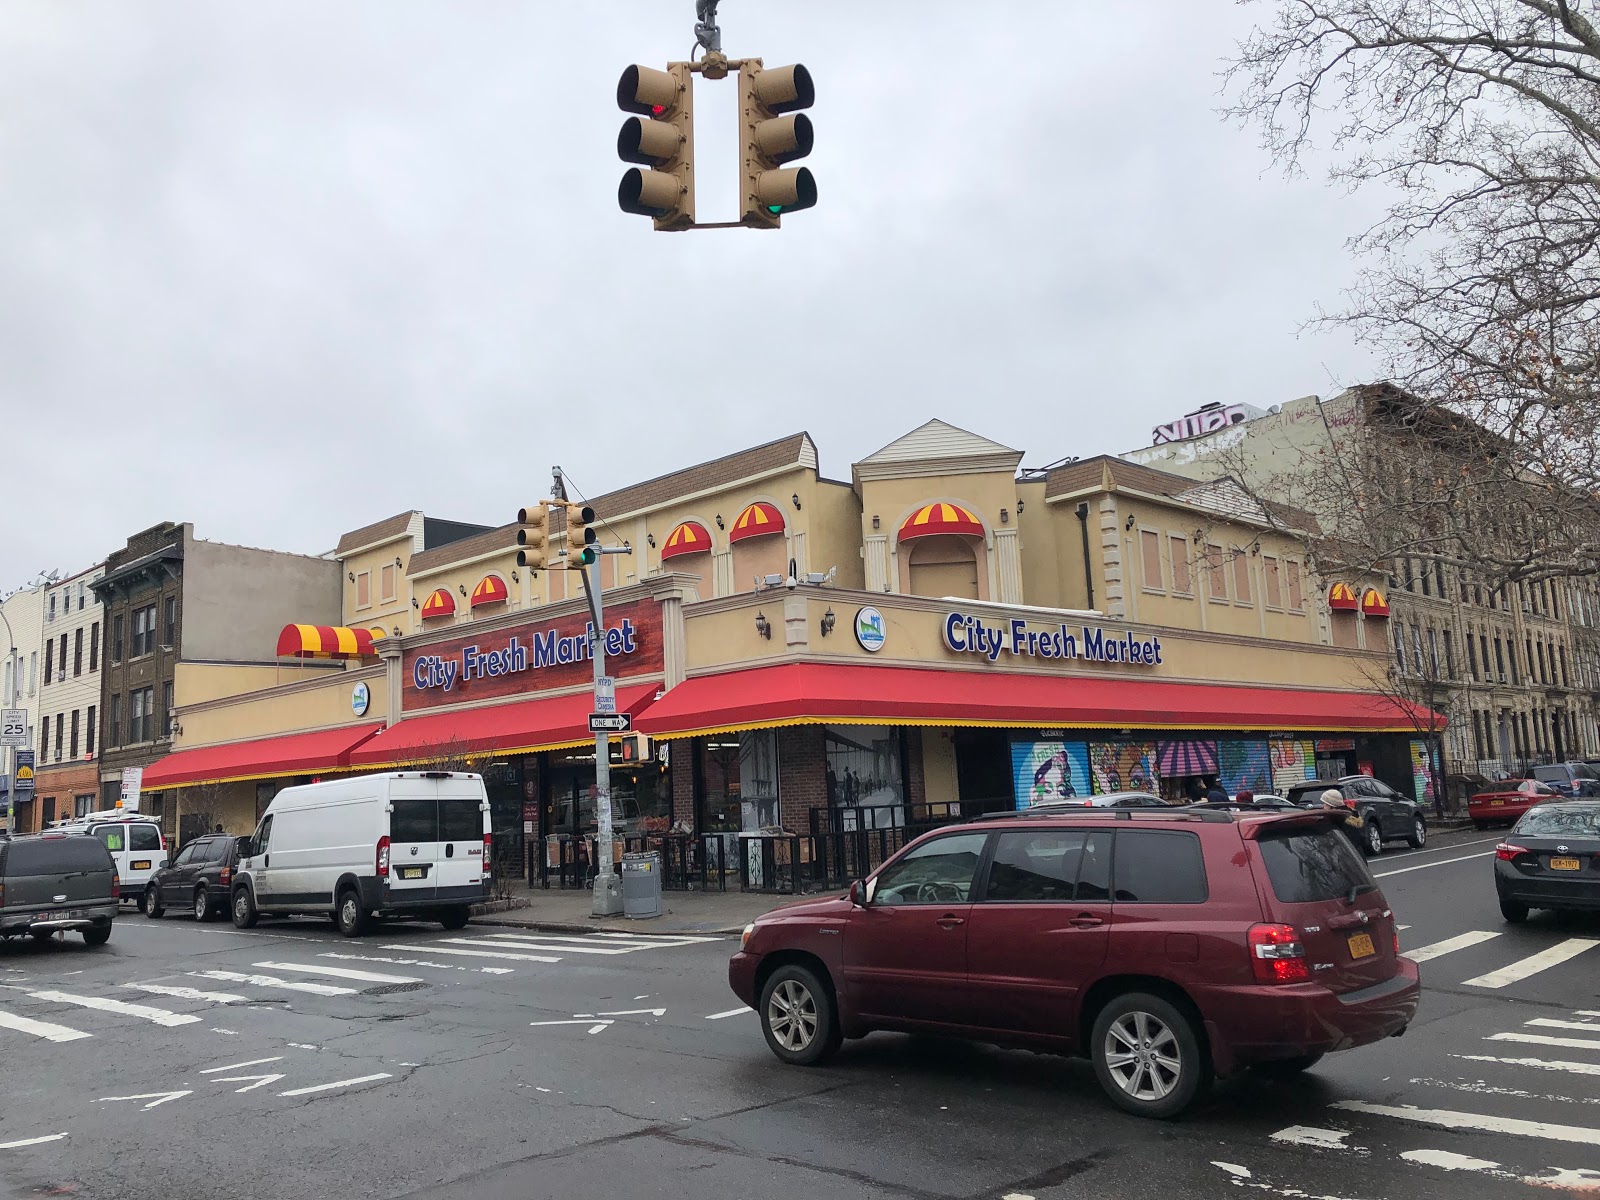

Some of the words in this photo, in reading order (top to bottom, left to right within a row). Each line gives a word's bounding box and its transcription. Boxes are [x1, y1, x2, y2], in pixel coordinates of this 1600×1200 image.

[944, 612, 1003, 661] City
[1009, 618, 1078, 660] Fresh
[1083, 626, 1163, 666] Market
[413, 655, 457, 691] City
[462, 637, 528, 681] Fresh
[597, 678, 612, 686] NYPD
[594, 719, 607, 727] ONE
[611, 719, 625, 727] WAY
[3, 724, 24, 735] 25
